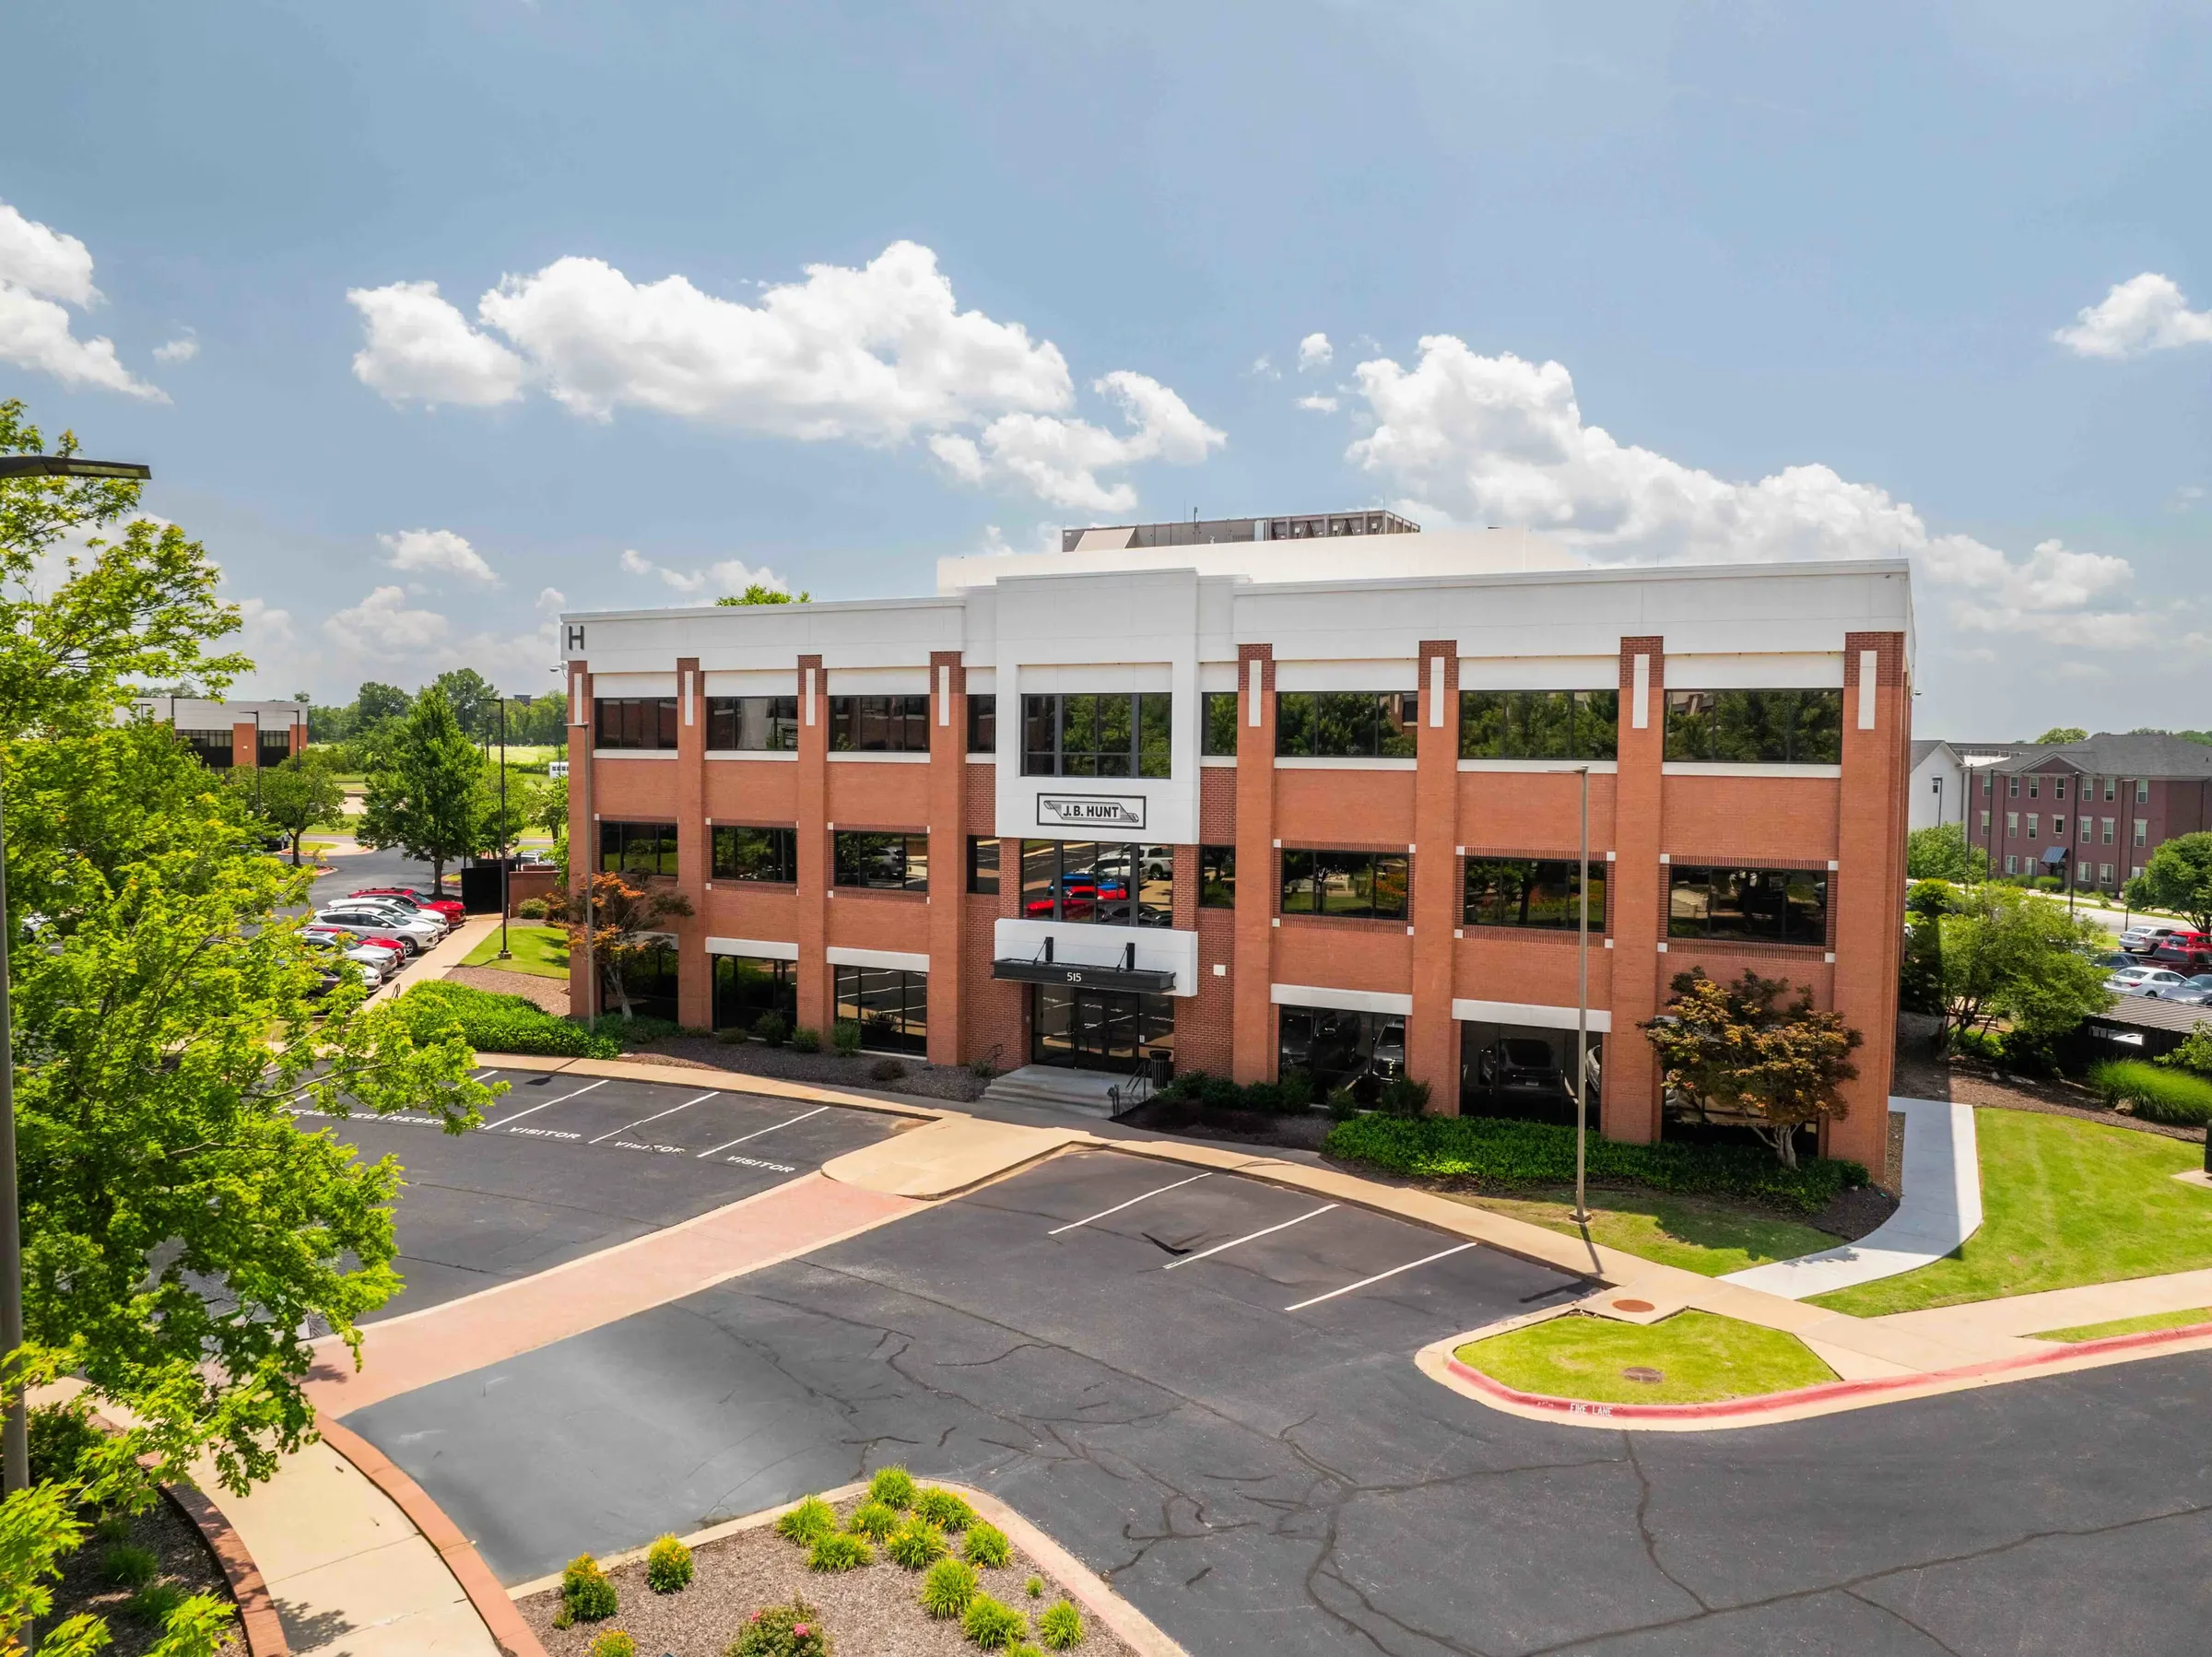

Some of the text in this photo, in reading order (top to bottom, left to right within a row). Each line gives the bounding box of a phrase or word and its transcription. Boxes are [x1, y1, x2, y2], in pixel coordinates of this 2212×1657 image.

[568, 625, 585, 651] H
[1086, 805, 1119, 818] HUNT
[1066, 971, 1082, 982] 515
[509, 1126, 582, 1139] VISITOR
[726, 1155, 796, 1173] VISITOR
[1570, 1403, 1587, 1415] FIRE
[1592, 1404, 1613, 1417] LANE
